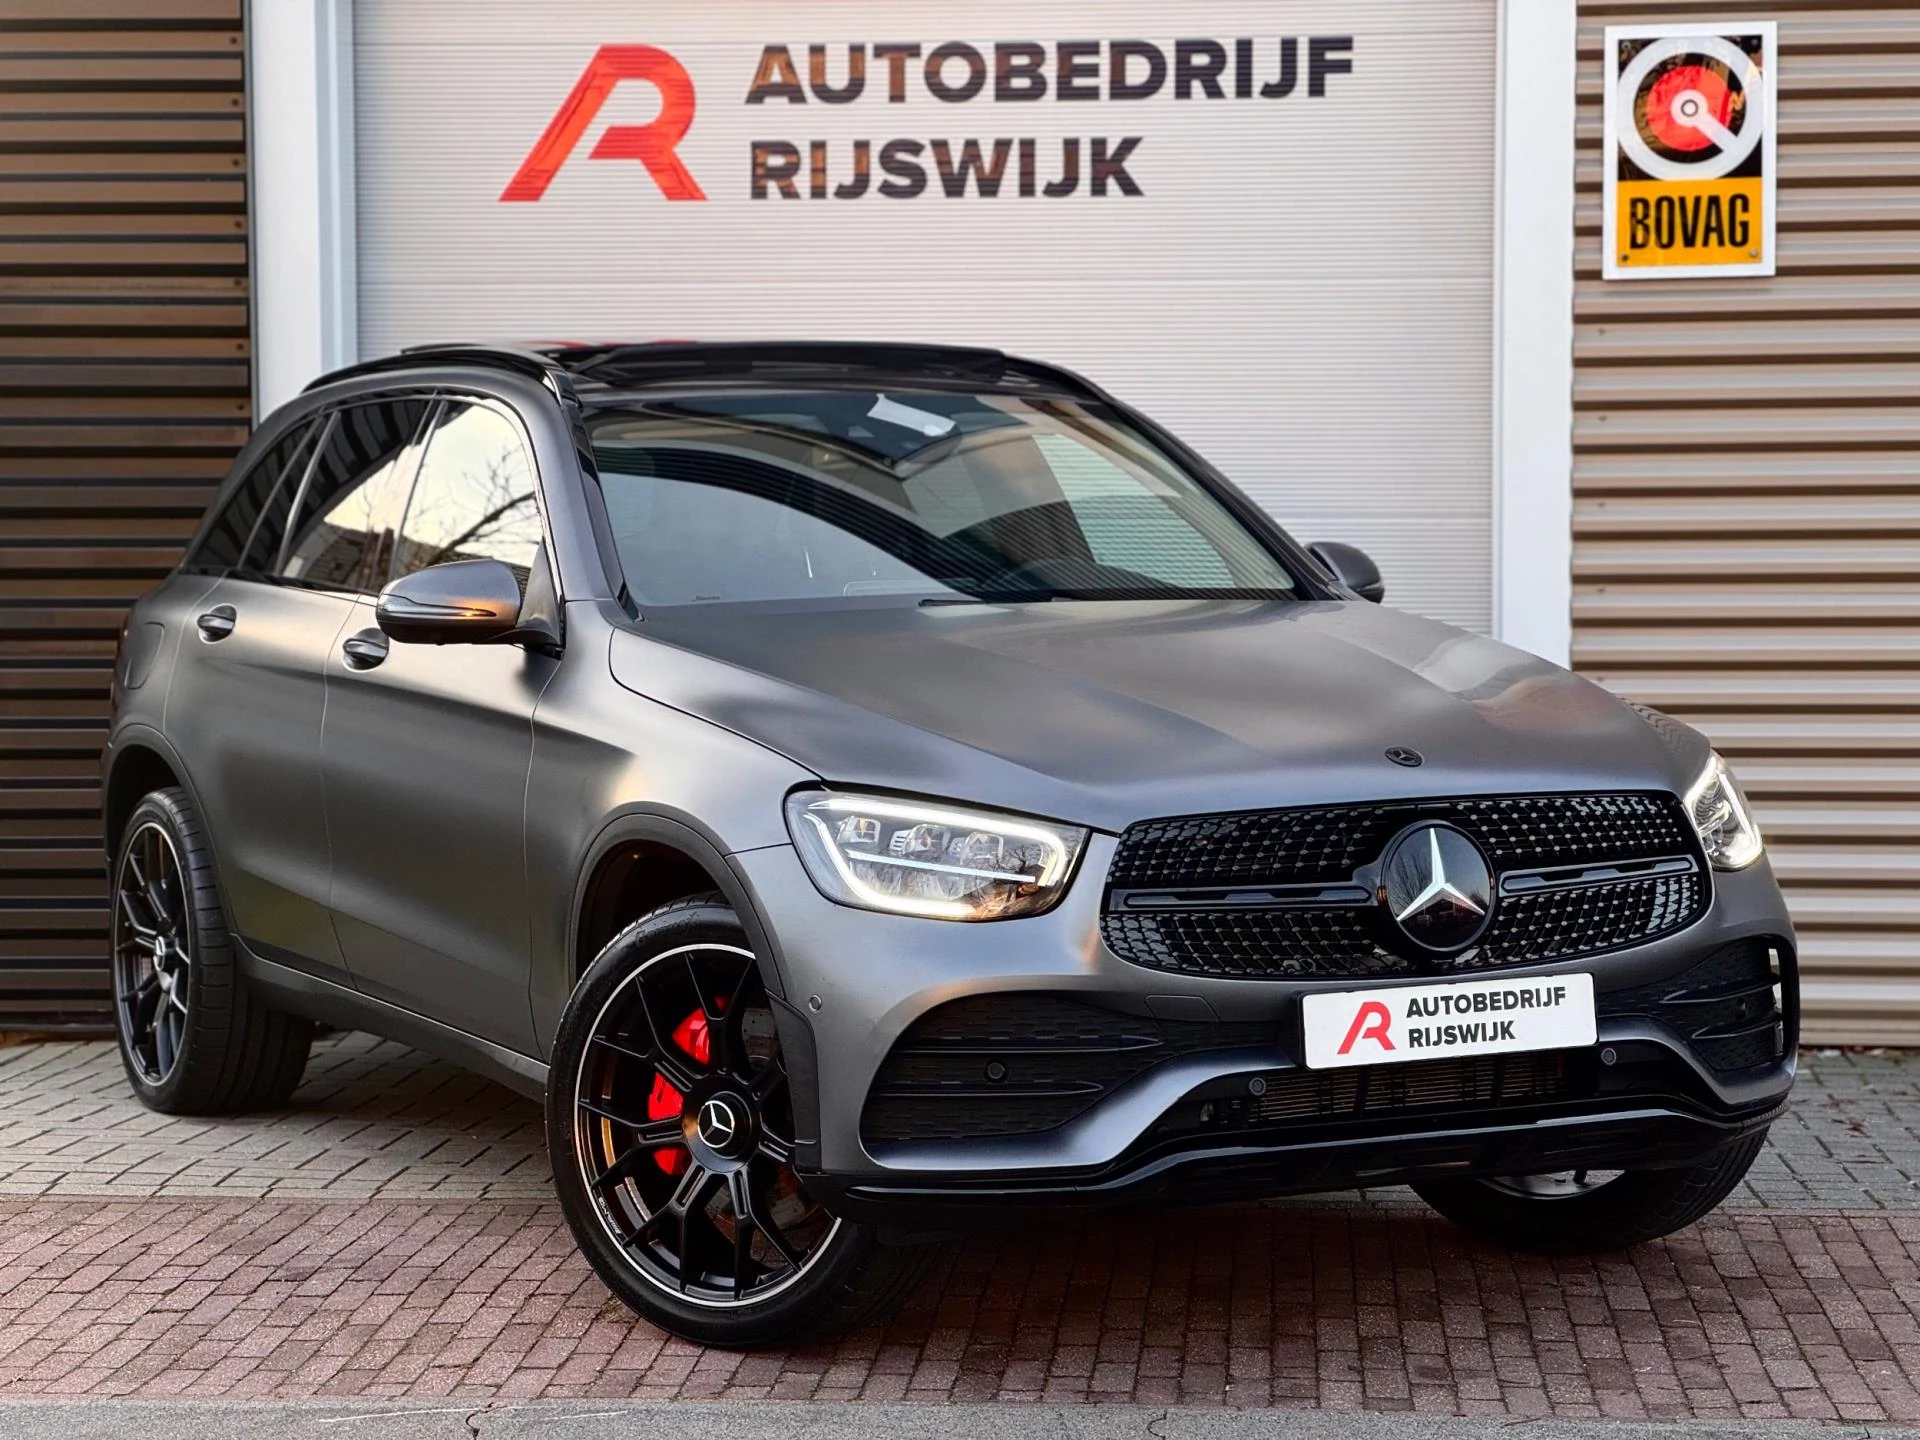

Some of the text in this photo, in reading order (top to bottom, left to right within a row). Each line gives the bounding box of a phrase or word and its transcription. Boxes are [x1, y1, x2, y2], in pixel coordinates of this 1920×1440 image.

[745, 37, 1353, 104] AUTOBEDRIJF
[750, 137, 1144, 199] RIJSWIJK
[1630, 193, 1749, 249] BOVAG
[1406, 987, 1566, 1017] AUTOBEDRIJF
[1408, 1020, 1516, 1048] RIJSWIJK
